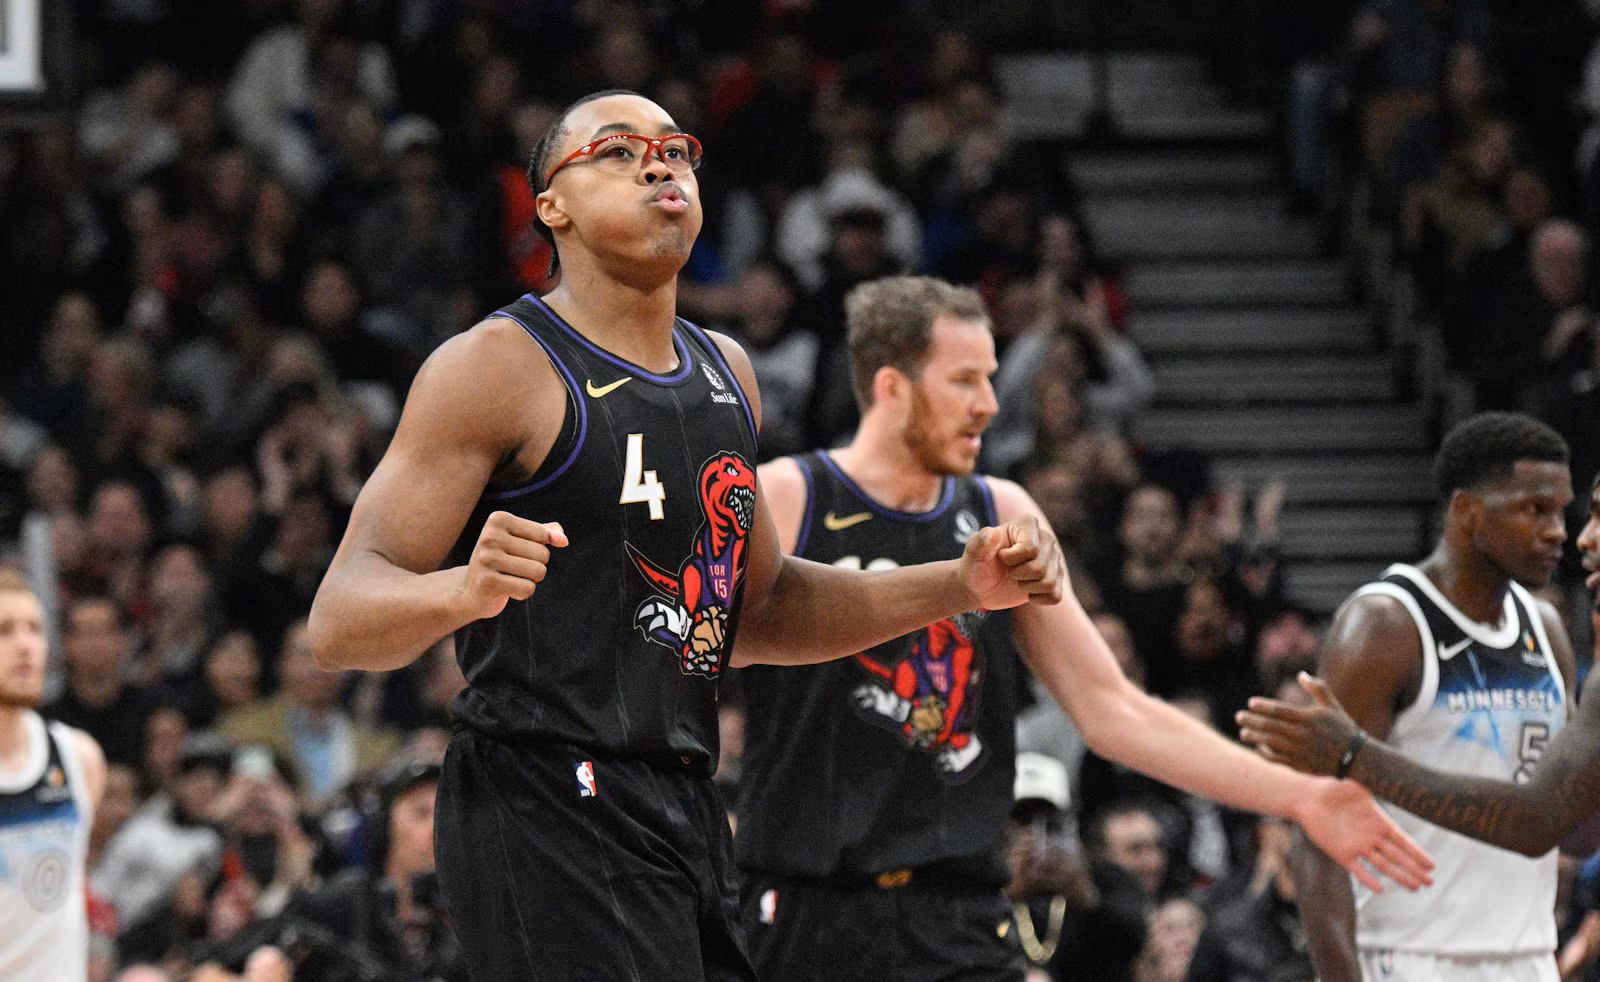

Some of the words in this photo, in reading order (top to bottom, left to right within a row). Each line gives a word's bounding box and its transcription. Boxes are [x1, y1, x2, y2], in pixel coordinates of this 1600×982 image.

[710, 391, 726, 403] Sun
[619, 433, 665, 520] 4
[709, 564, 725, 577] TOR
[714, 579, 727, 598] 15
